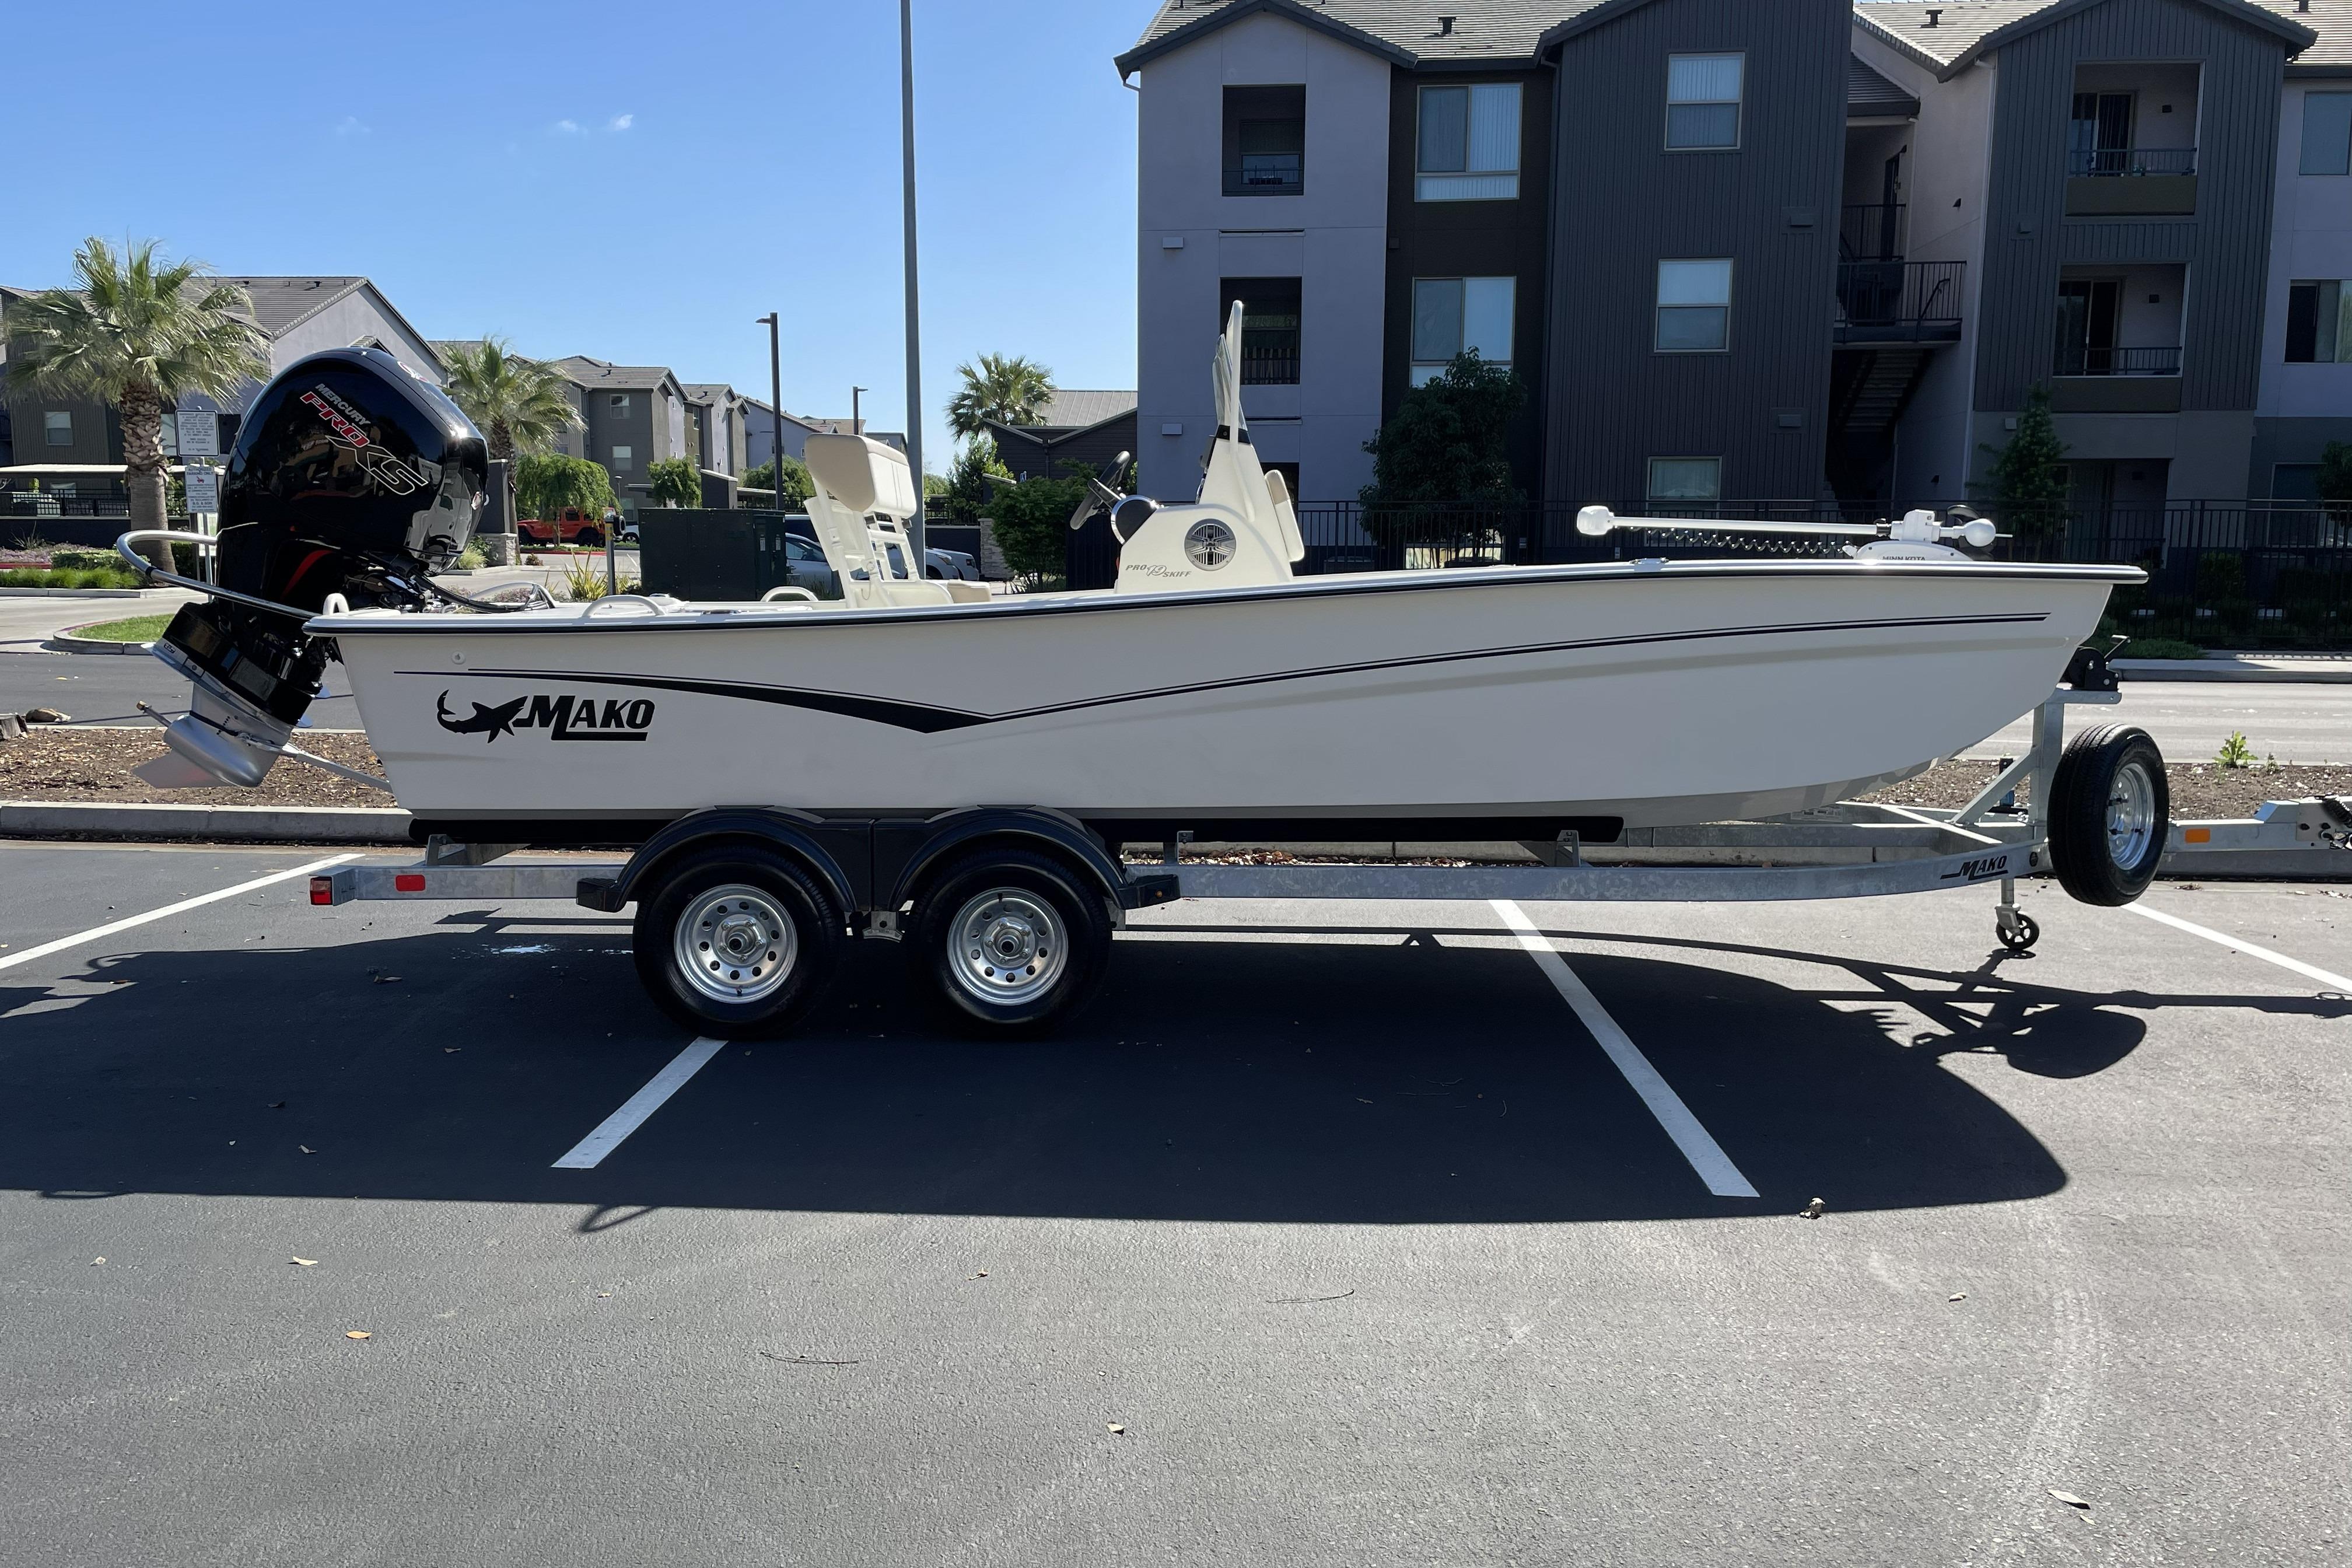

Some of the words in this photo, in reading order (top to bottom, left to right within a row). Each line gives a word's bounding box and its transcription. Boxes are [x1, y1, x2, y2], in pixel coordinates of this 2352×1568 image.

[300, 391, 370, 448] PRO
[315, 383, 371, 426] MERCURY
[325, 423, 429, 495] XS
[1146, 565, 1167, 577] 19
[512, 695, 656, 741] MAKO
[1940, 855, 2009, 881] MAKO
